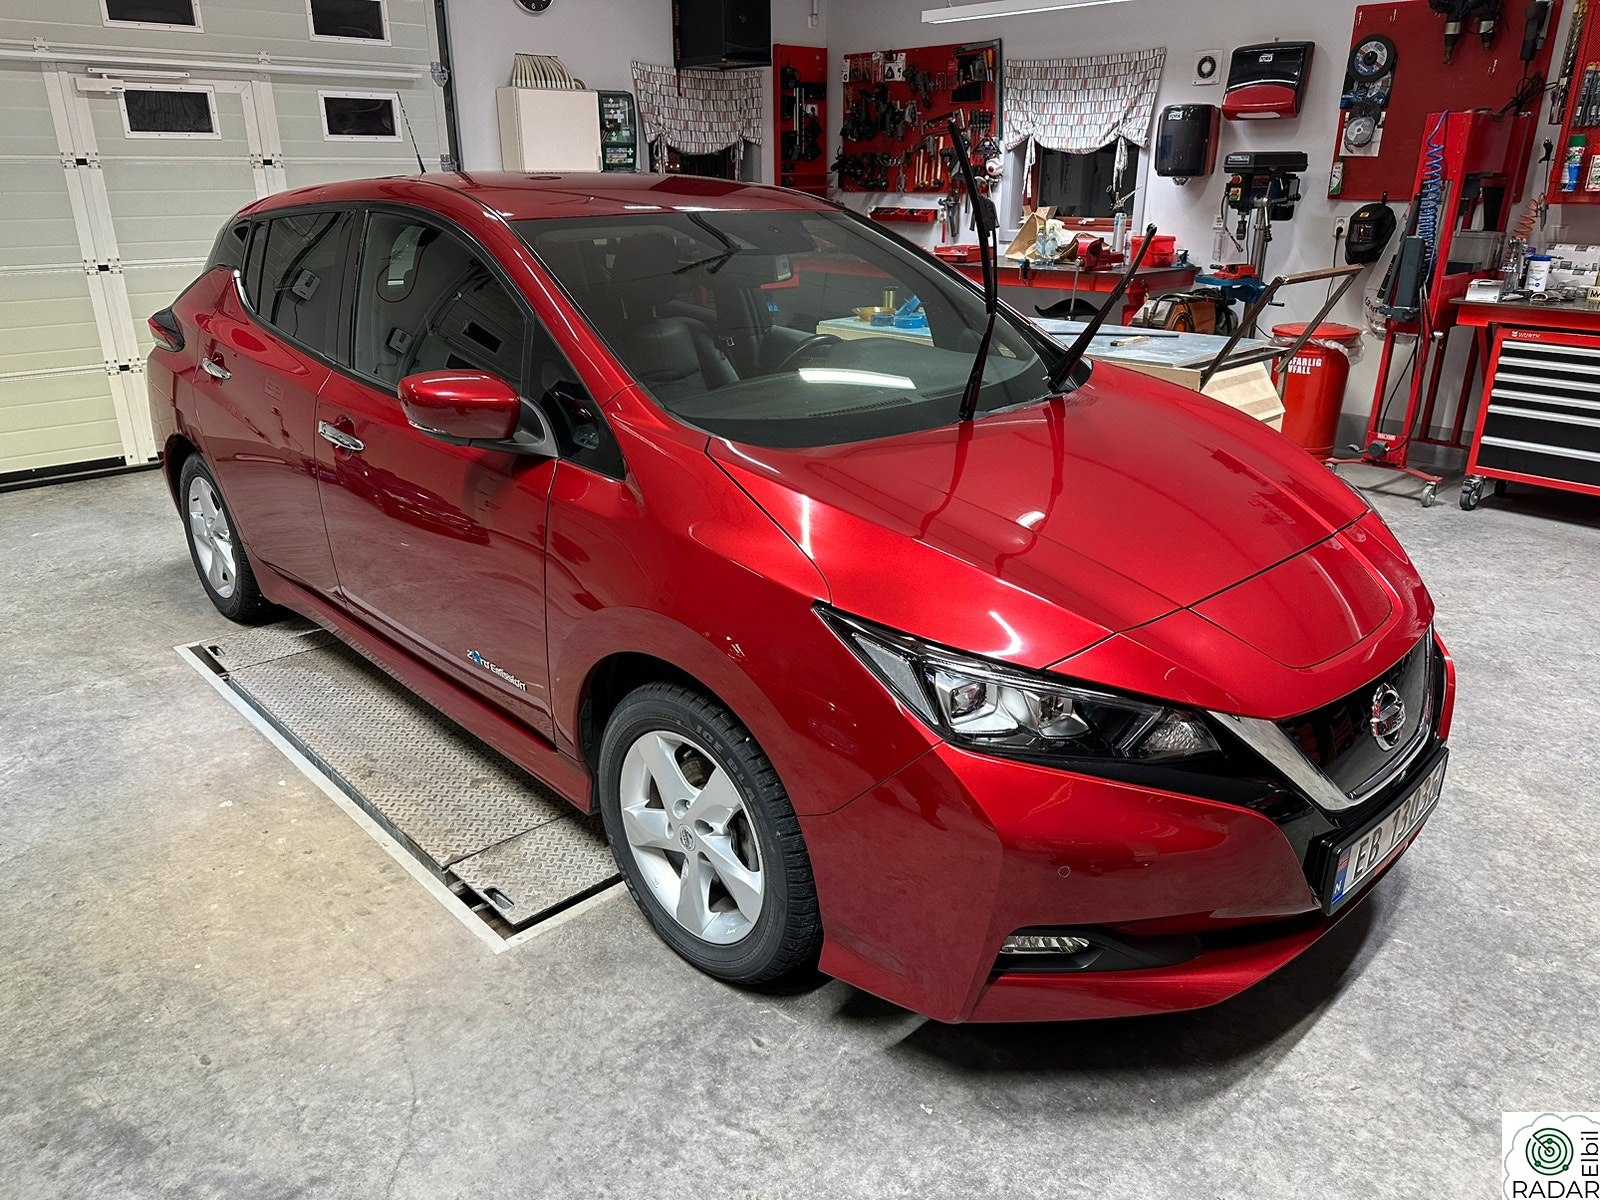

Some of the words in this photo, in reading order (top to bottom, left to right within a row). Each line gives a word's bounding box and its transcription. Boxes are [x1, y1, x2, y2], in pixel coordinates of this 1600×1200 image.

[1287, 364, 1311, 375] VFALL
[695, 725, 723, 753] ICE
[1353, 826, 1382, 880] EB
[1333, 881, 1342, 894] N
